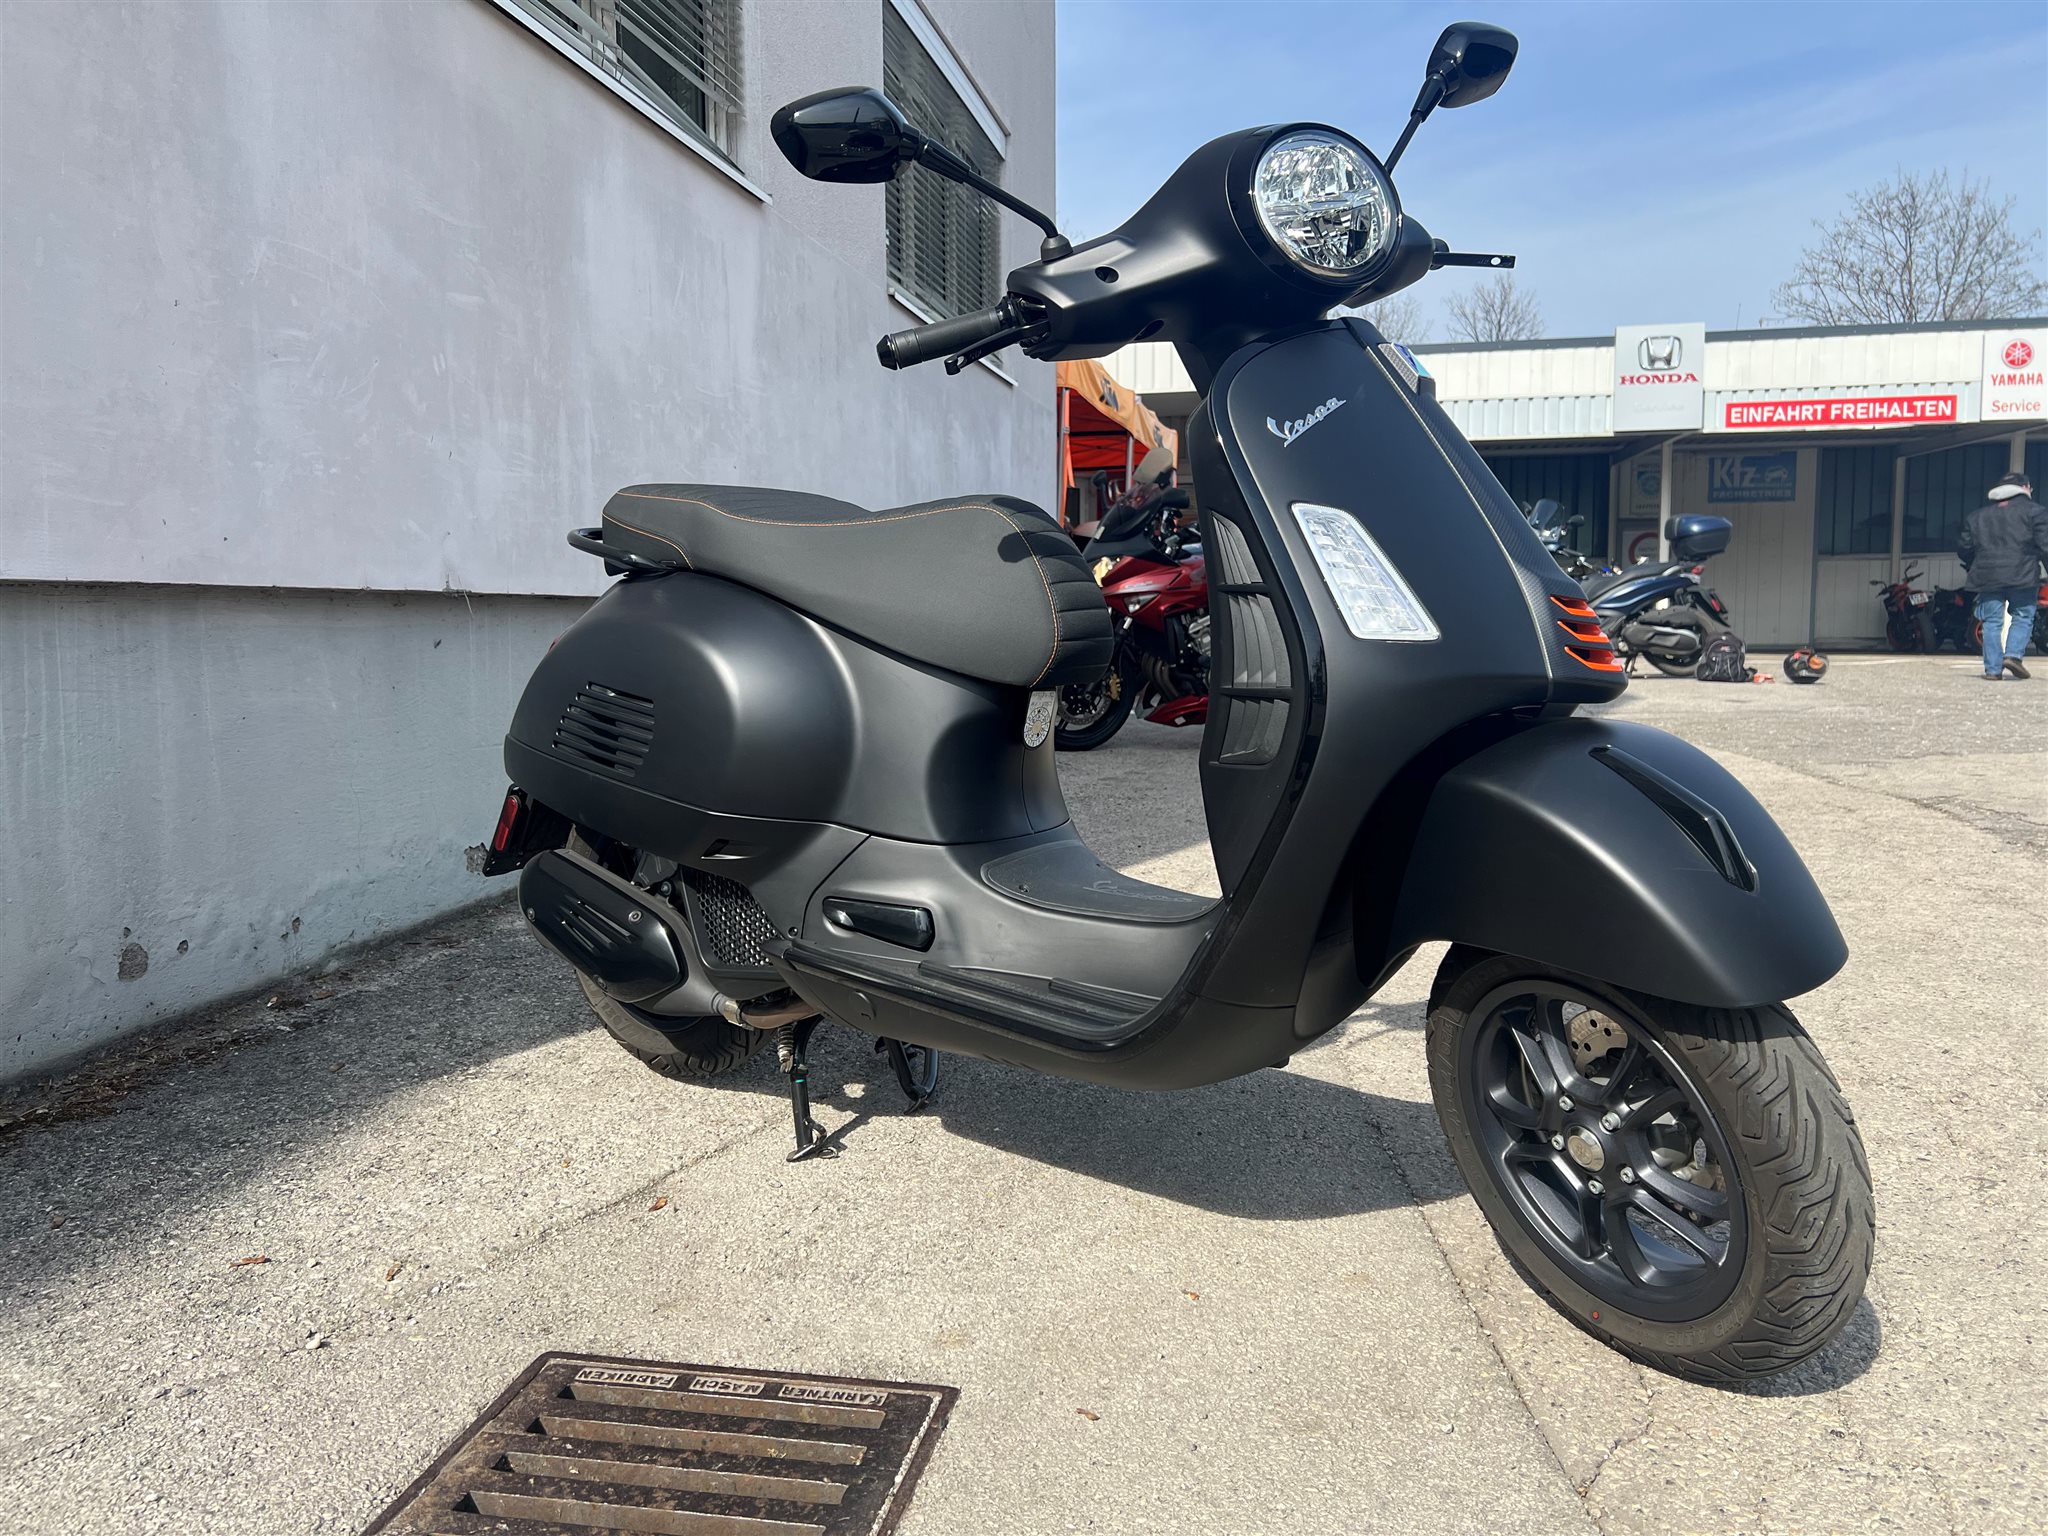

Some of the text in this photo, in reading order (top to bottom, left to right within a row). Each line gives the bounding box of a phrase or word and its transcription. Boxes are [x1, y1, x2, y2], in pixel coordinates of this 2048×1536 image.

[1619, 372, 1699, 386] HONDA
[1990, 372, 2044, 386] YAMAHA
[1729, 399, 1953, 425] EINFAHRT FREIHALTEN
[1991, 398, 2041, 413] Service
[1266, 397, 1347, 448] Vespa
[577, 1368, 676, 1388] FABRIKEN
